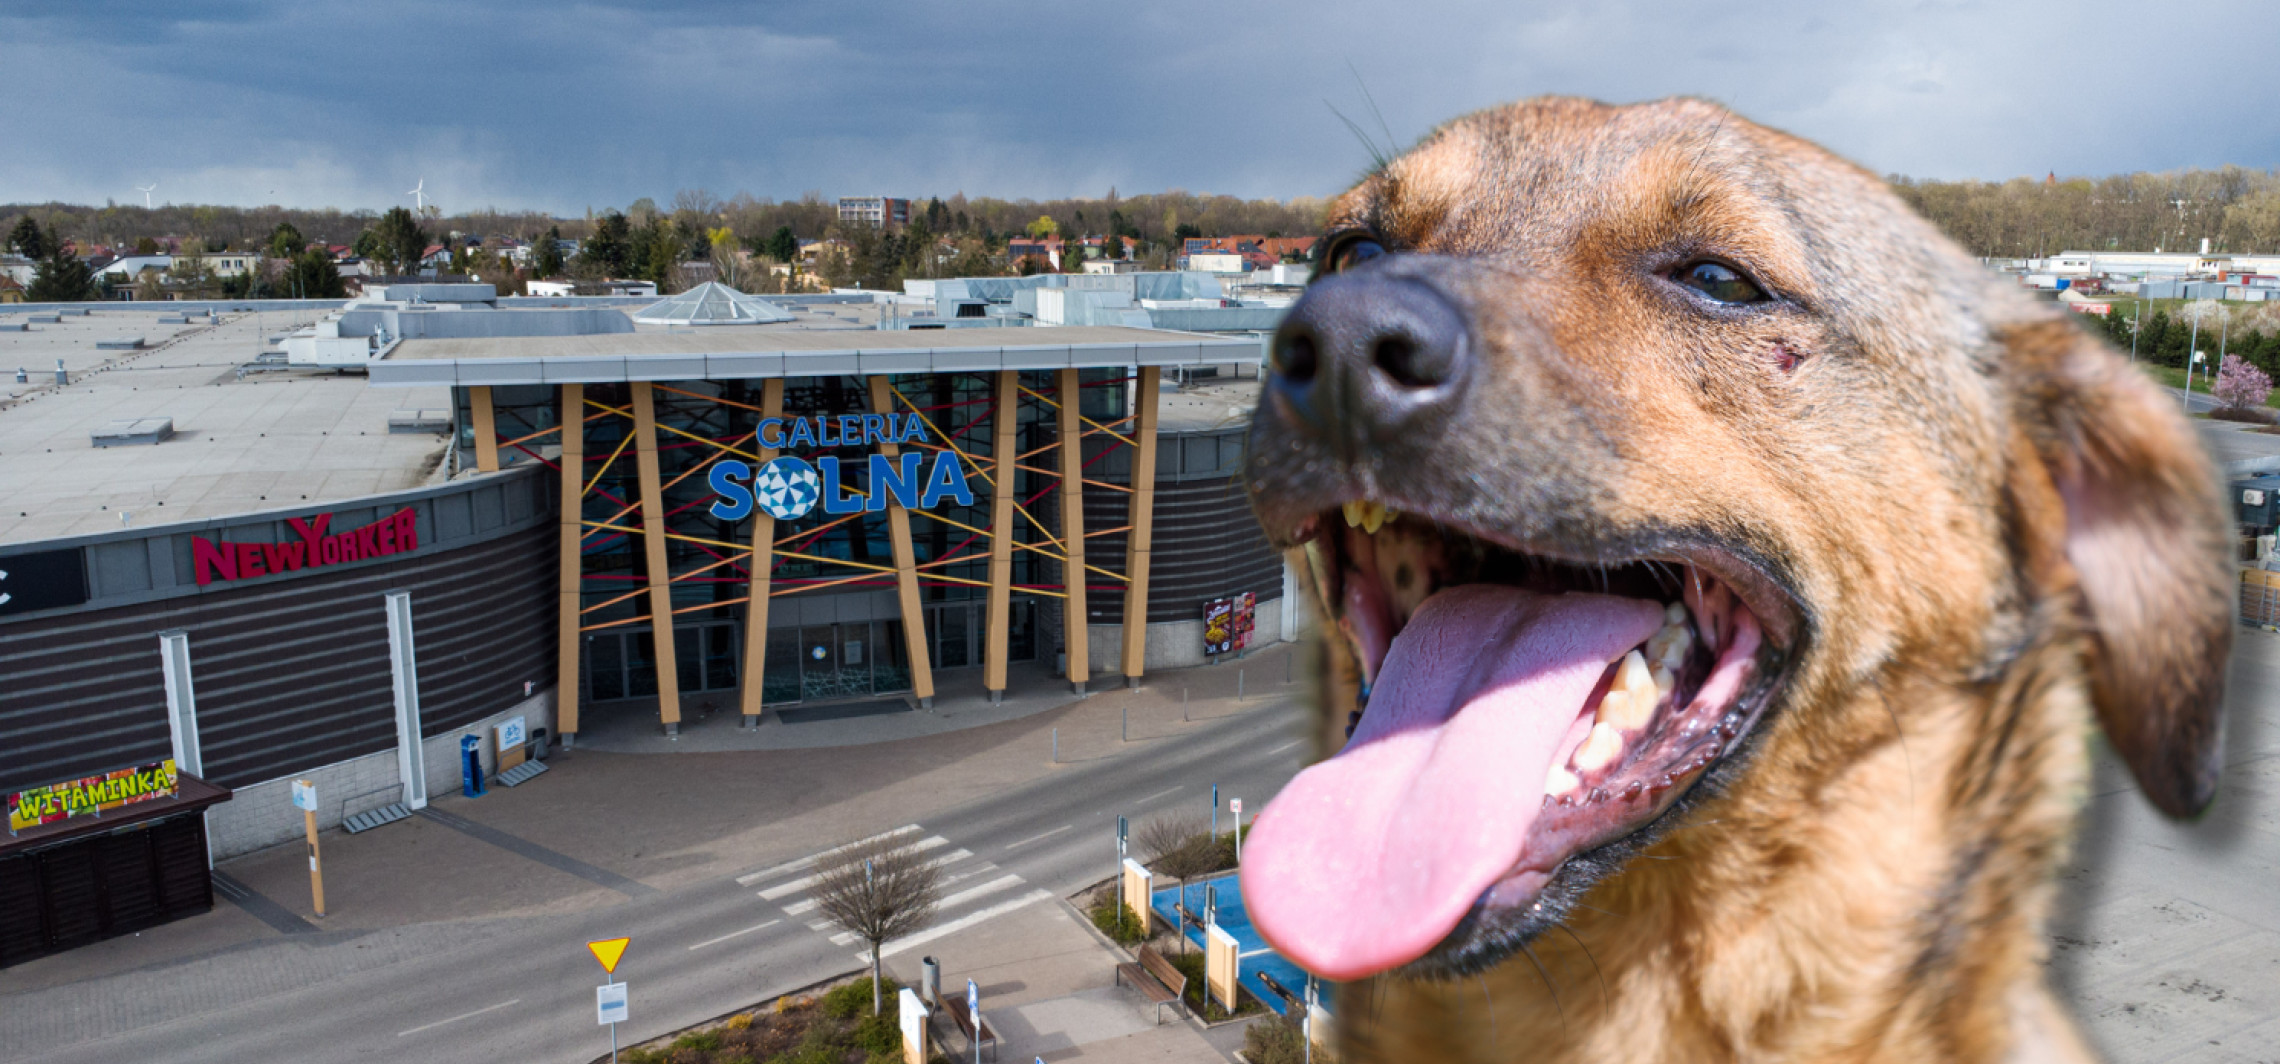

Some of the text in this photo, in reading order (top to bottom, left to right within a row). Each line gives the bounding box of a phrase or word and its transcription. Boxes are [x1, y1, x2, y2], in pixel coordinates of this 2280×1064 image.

[756, 412, 928, 449] GALERIA
[708, 450, 974, 521] SOLNA
[18, 768, 170, 820] WITAMINKA
